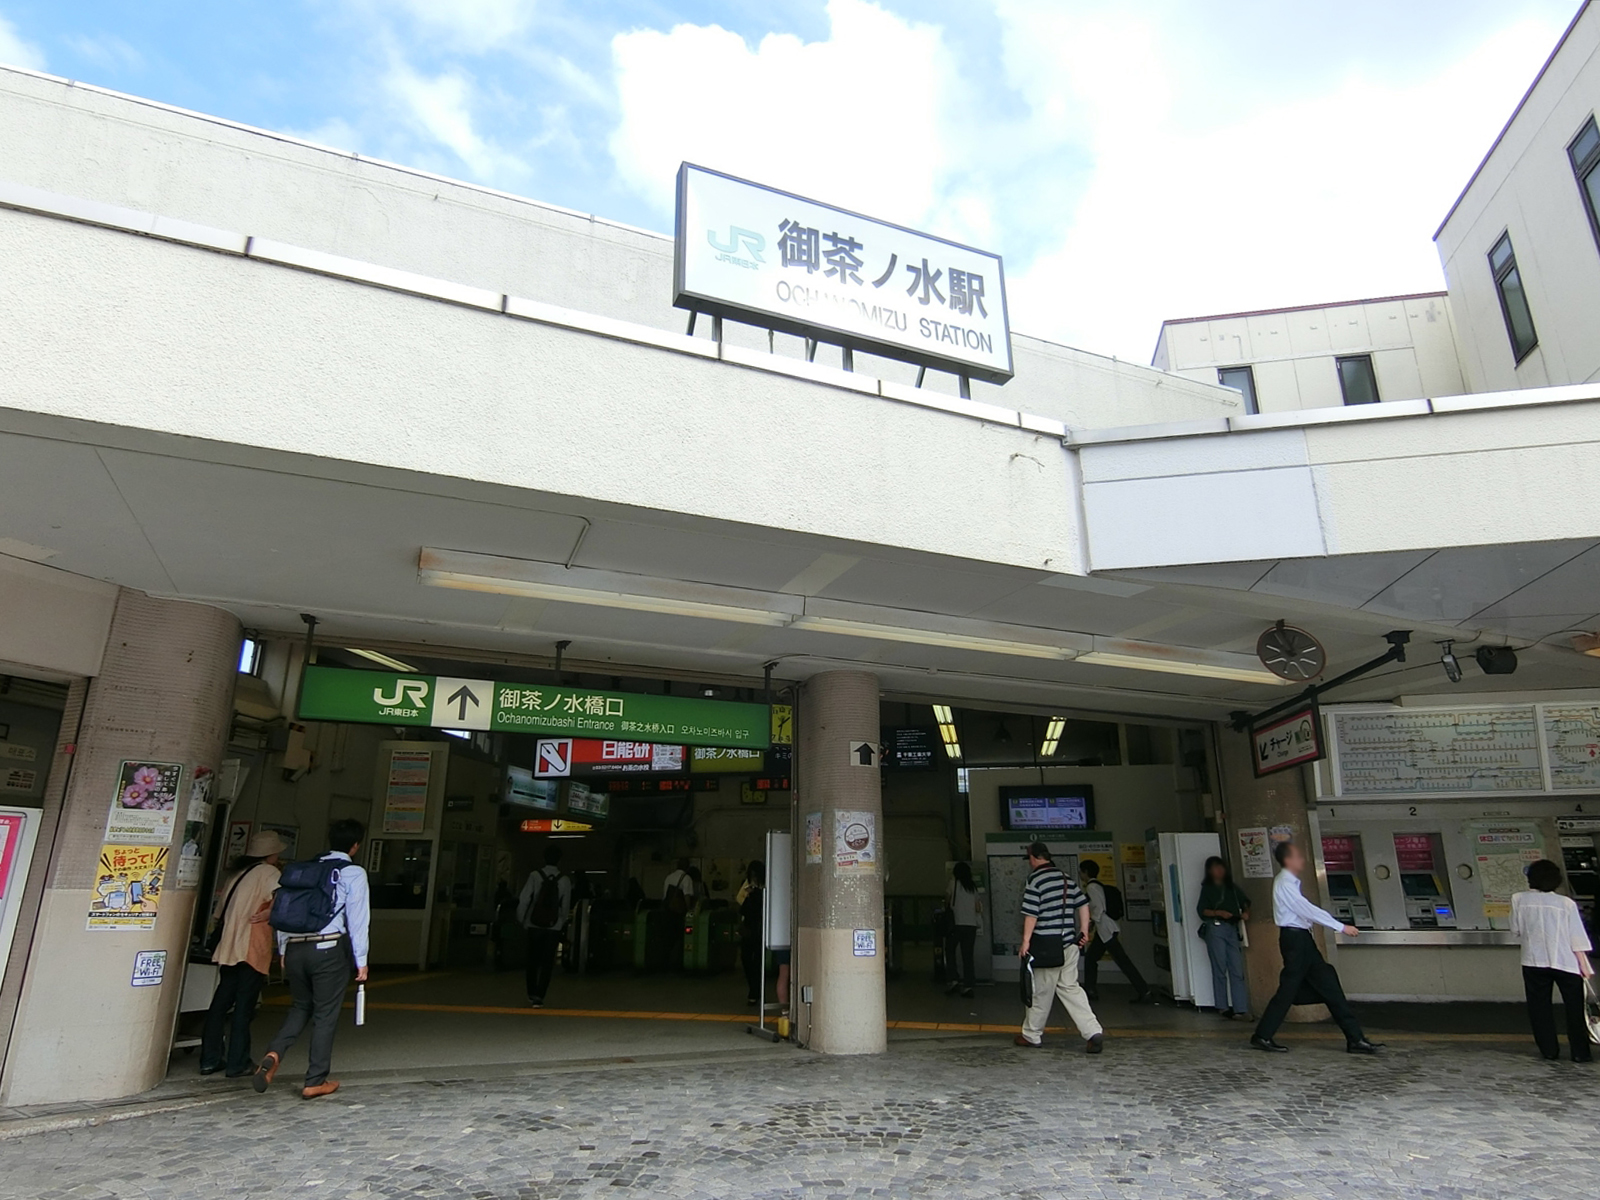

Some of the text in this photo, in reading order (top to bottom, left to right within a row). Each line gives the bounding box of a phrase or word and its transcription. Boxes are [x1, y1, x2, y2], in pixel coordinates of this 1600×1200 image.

[707, 224, 766, 264] JR
[776, 217, 988, 319] 御茶ノ水駅
[776, 280, 993, 354] OCHMIZU STATION
[373, 679, 428, 708] JR
[499, 687, 624, 717] 御茶ノ水橋口
[378, 707, 419, 718] JR東日本
[497, 711, 615, 731] Ochanomizubashi Entrance
[621, 720, 675, 734] 御茶之水桥入口
[734, 729, 750, 740] 입구
[1270, 730, 1292, 751] チャージ
[602, 740, 650, 759] 日能研
[694, 747, 760, 760] 御茶ノ水橋口
[1330, 808, 1335, 817] 1
[1409, 806, 1417, 816] 2
[1575, 803, 1582, 812] 4
[521, 820, 528, 831] 4
[113, 853, 154, 867] 待って!
[140, 958, 161, 968] FREE
